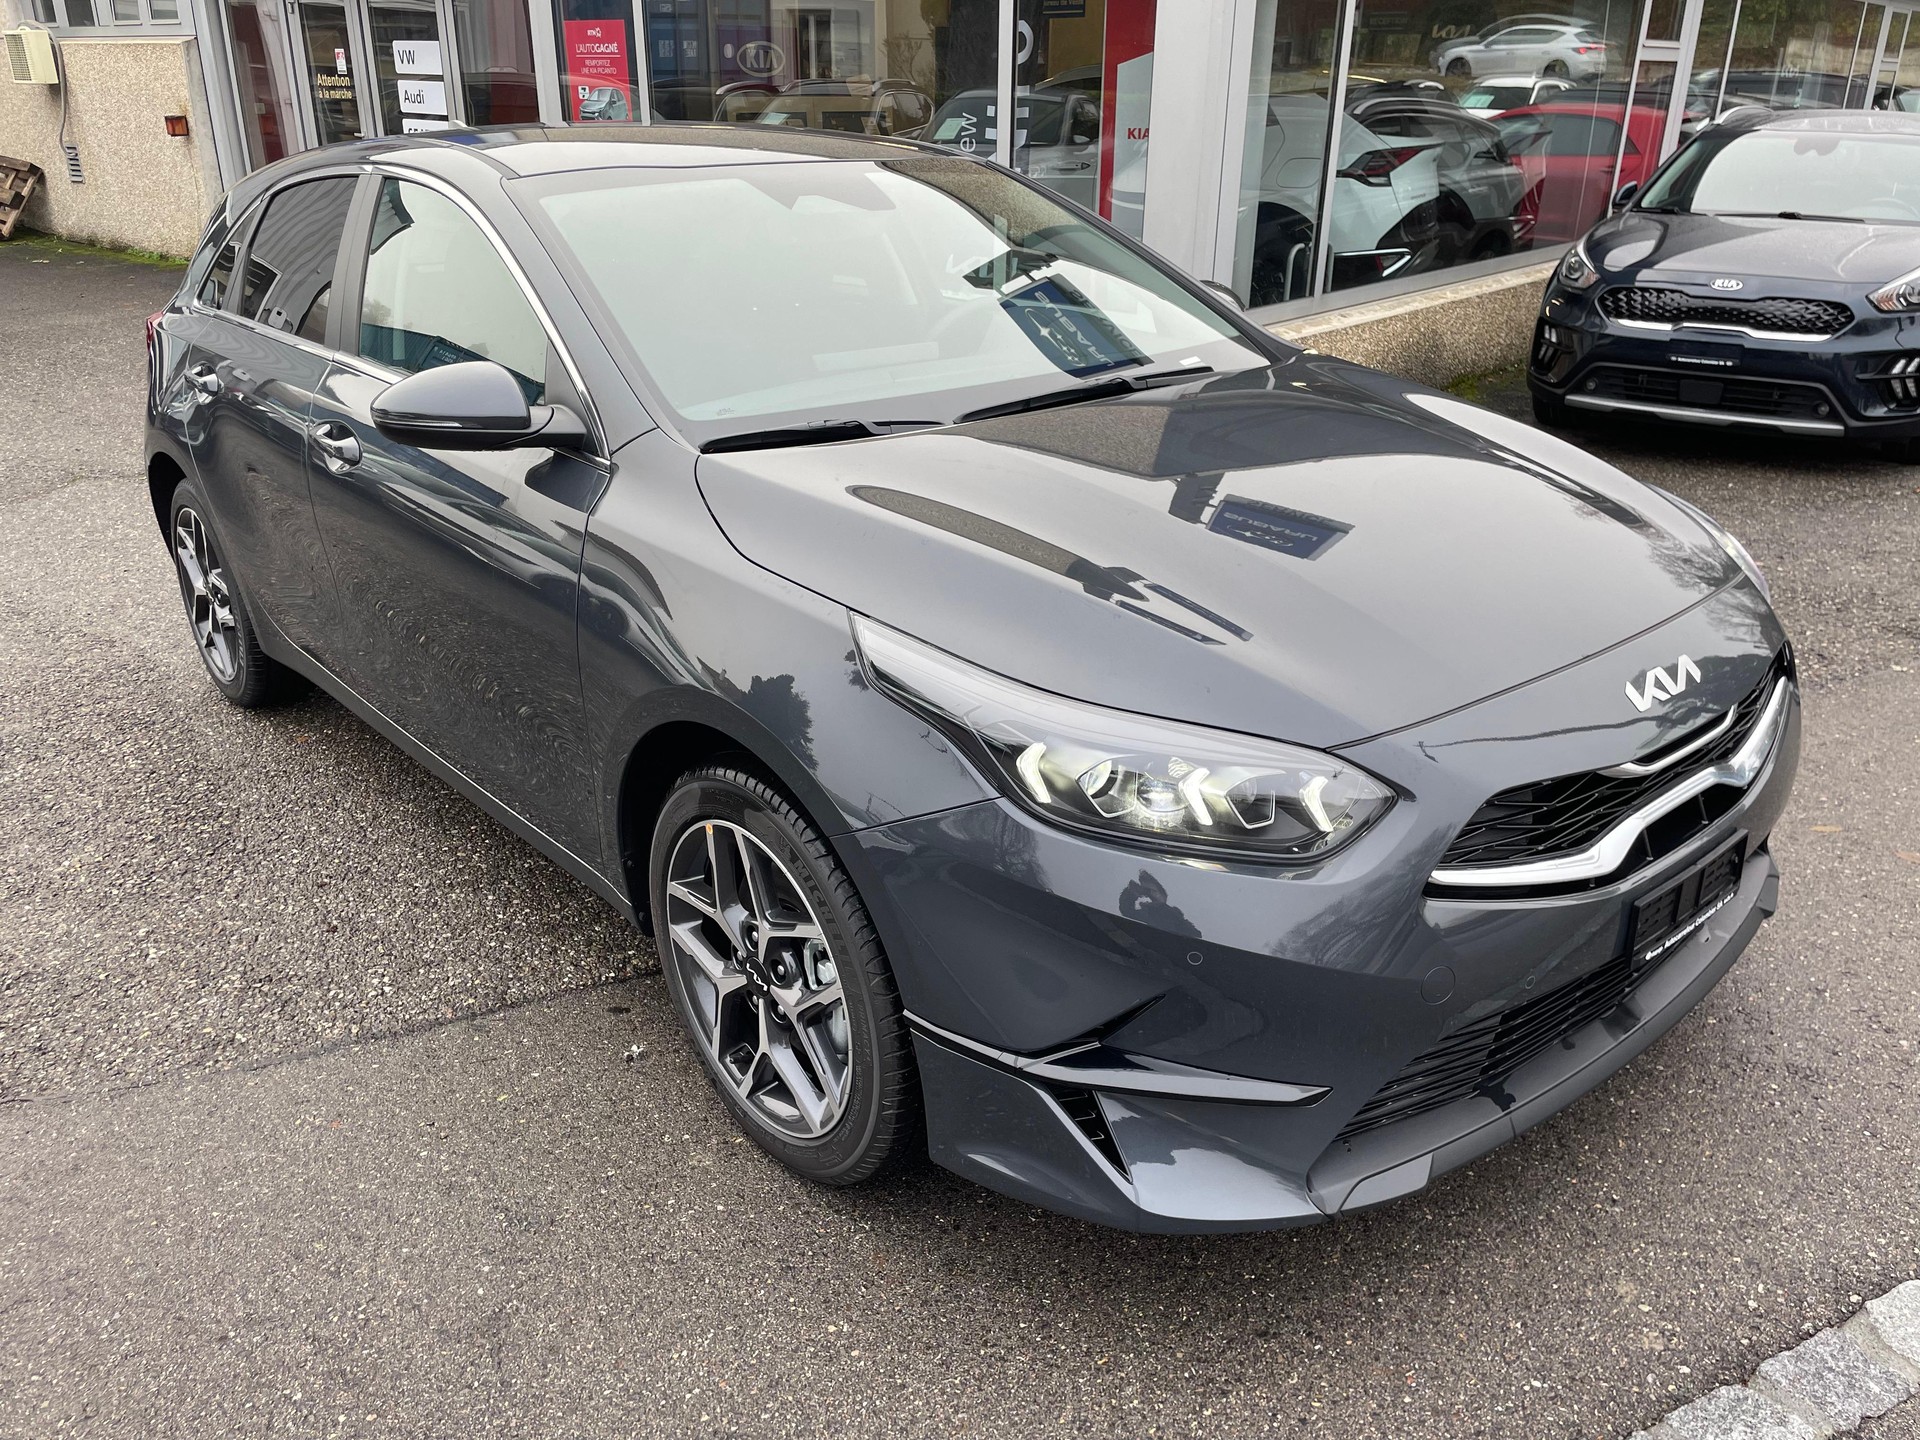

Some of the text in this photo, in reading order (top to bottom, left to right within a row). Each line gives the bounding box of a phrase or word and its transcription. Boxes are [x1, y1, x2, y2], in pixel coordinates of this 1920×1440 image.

[397, 49, 415, 65] VW
[744, 44, 780, 69] KIA
[317, 73, 351, 87] Attention
[323, 89, 329, 99] la
[330, 89, 352, 99] marche
[403, 89, 425, 105] Audi
[960, 112, 977, 152] ew
[1127, 127, 1150, 140] KIA
[1713, 278, 1740, 289] KIA
[1625, 654, 1701, 713] KIA
